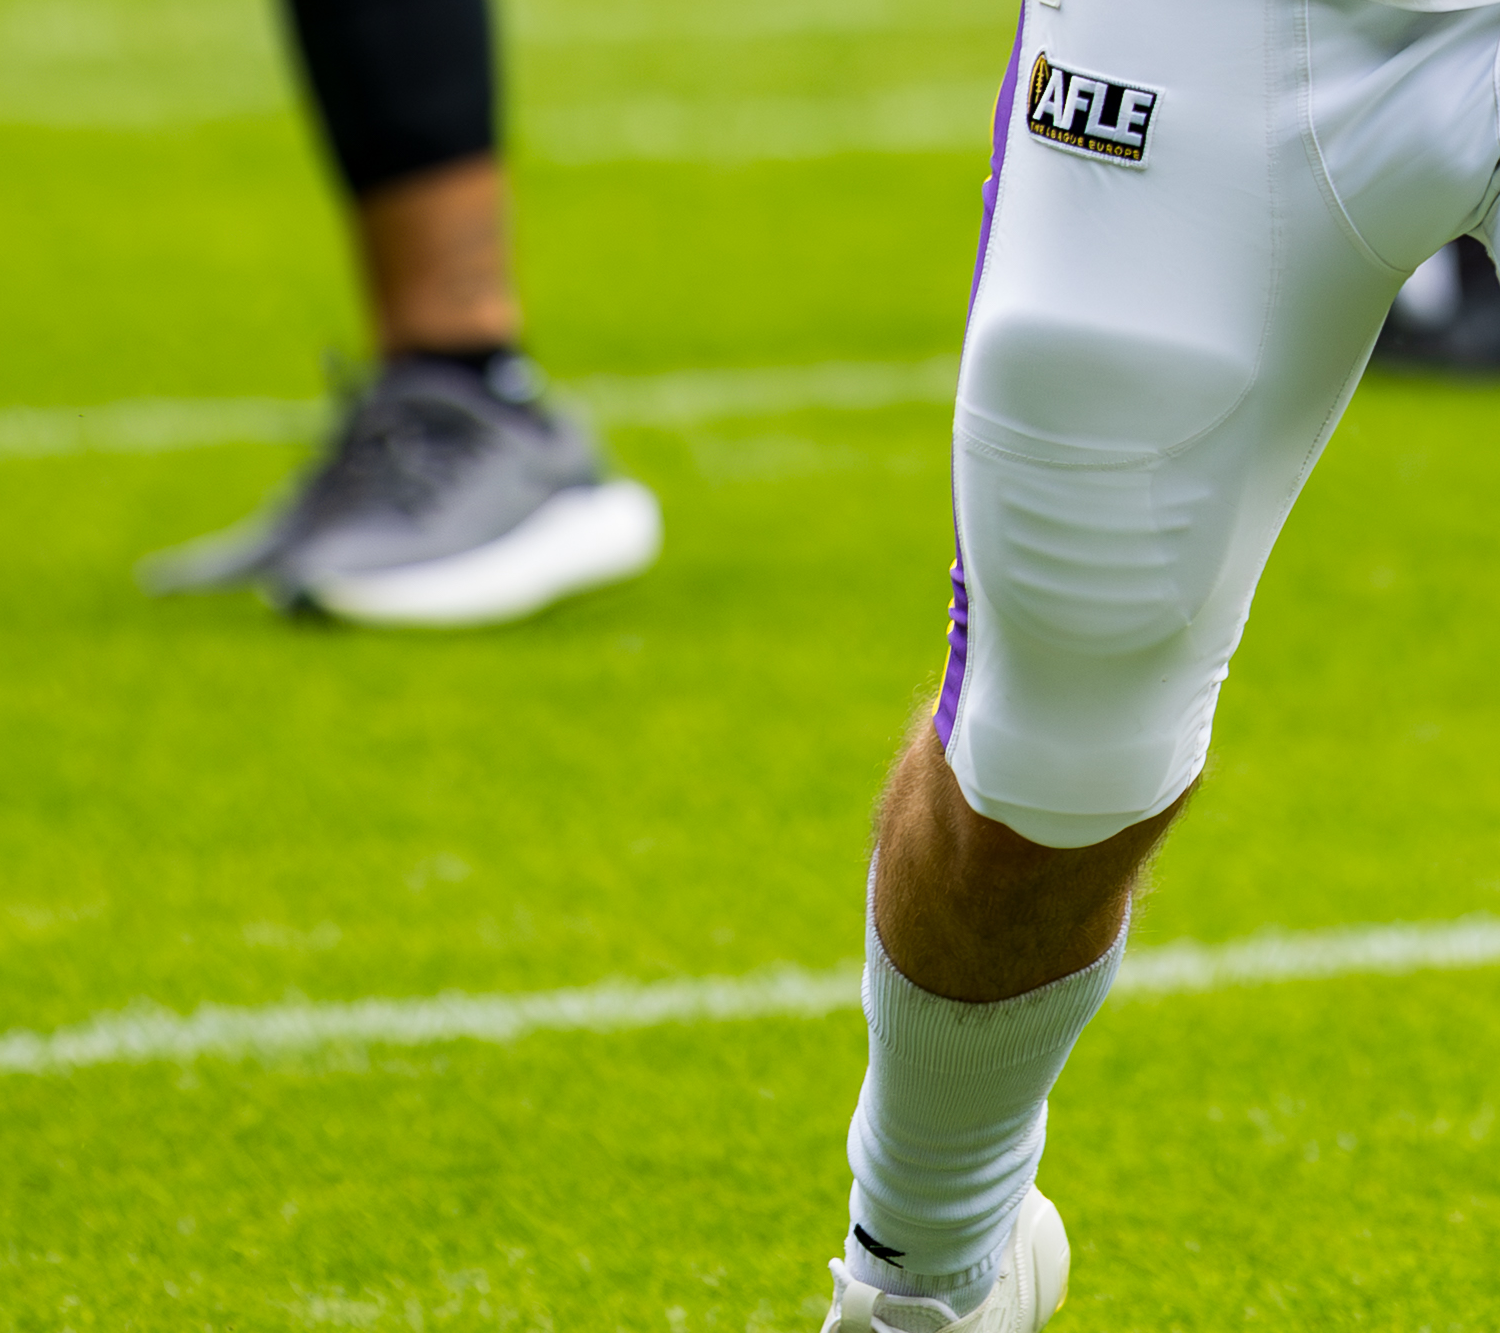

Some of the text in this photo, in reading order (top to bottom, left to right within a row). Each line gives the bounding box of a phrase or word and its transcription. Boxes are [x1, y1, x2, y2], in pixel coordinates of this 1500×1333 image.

[1032, 68, 1154, 148] AFLE
[1045, 127, 1085, 147] LEAGUE
[1088, 139, 1140, 160] EUROPE
